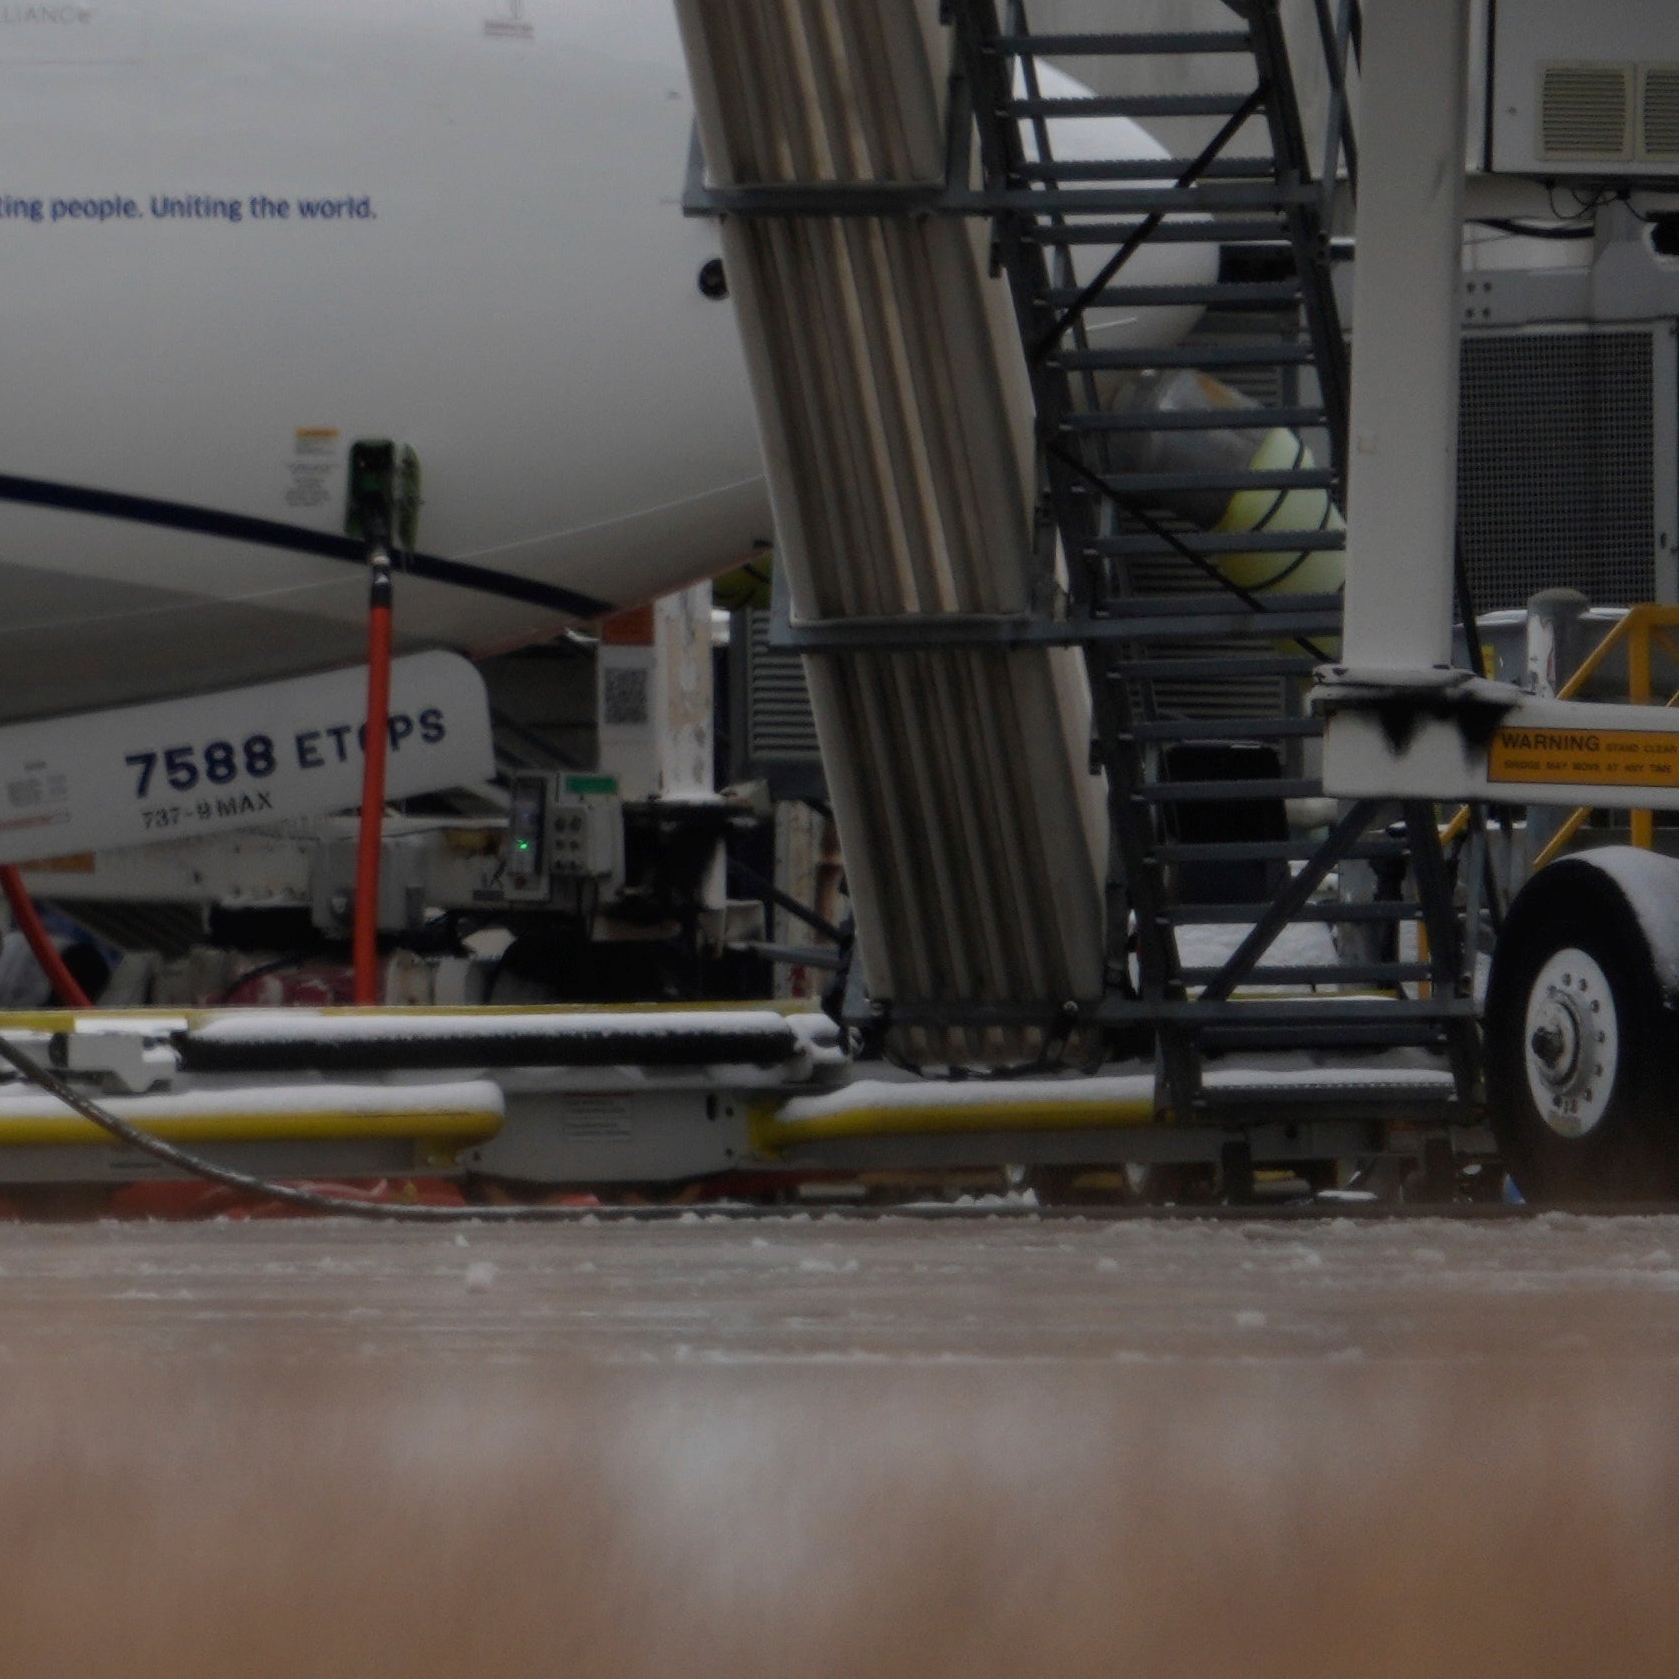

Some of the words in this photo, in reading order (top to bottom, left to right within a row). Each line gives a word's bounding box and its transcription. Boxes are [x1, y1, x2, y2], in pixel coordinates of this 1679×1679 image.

[51, 195, 142, 221] people.
[150, 195, 241, 222] Uniting
[249, 195, 290, 218] the
[297, 195, 377, 219] world.
[1502, 733, 1600, 752] WARNING
[125, 734, 277, 800] 7588
[217, 791, 274, 819] MAX
